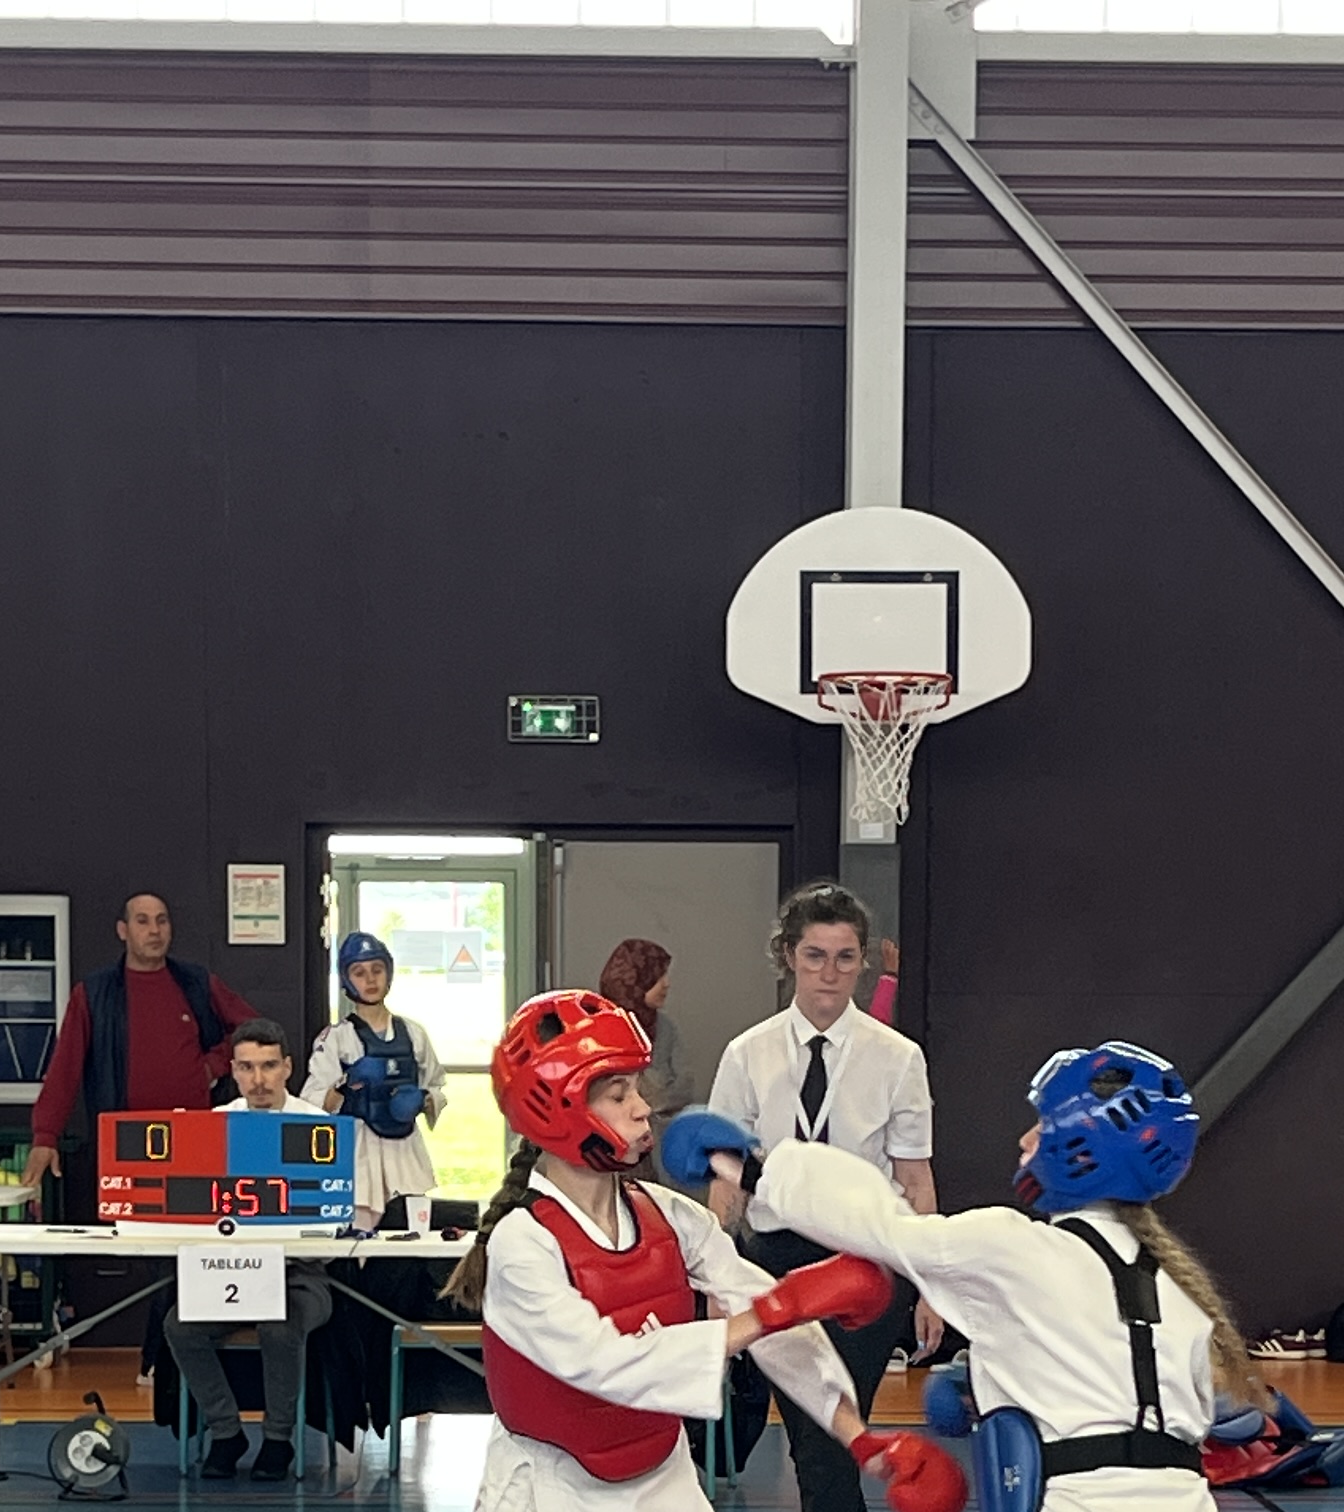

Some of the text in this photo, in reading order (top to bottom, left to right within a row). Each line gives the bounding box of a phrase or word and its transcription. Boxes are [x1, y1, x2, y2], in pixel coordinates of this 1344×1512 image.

[145, 1123, 169, 1160] 0
[311, 1125, 335, 1162] 0
[100, 1176, 132, 1190] CAT.1
[321, 1178, 353, 1193] CAT.1
[211, 1178, 288, 1216] 1:57
[99, 1201, 133, 1216] CAT.2
[201, 1257, 263, 1271] TABLEAU
[224, 1283, 240, 1304] 2
